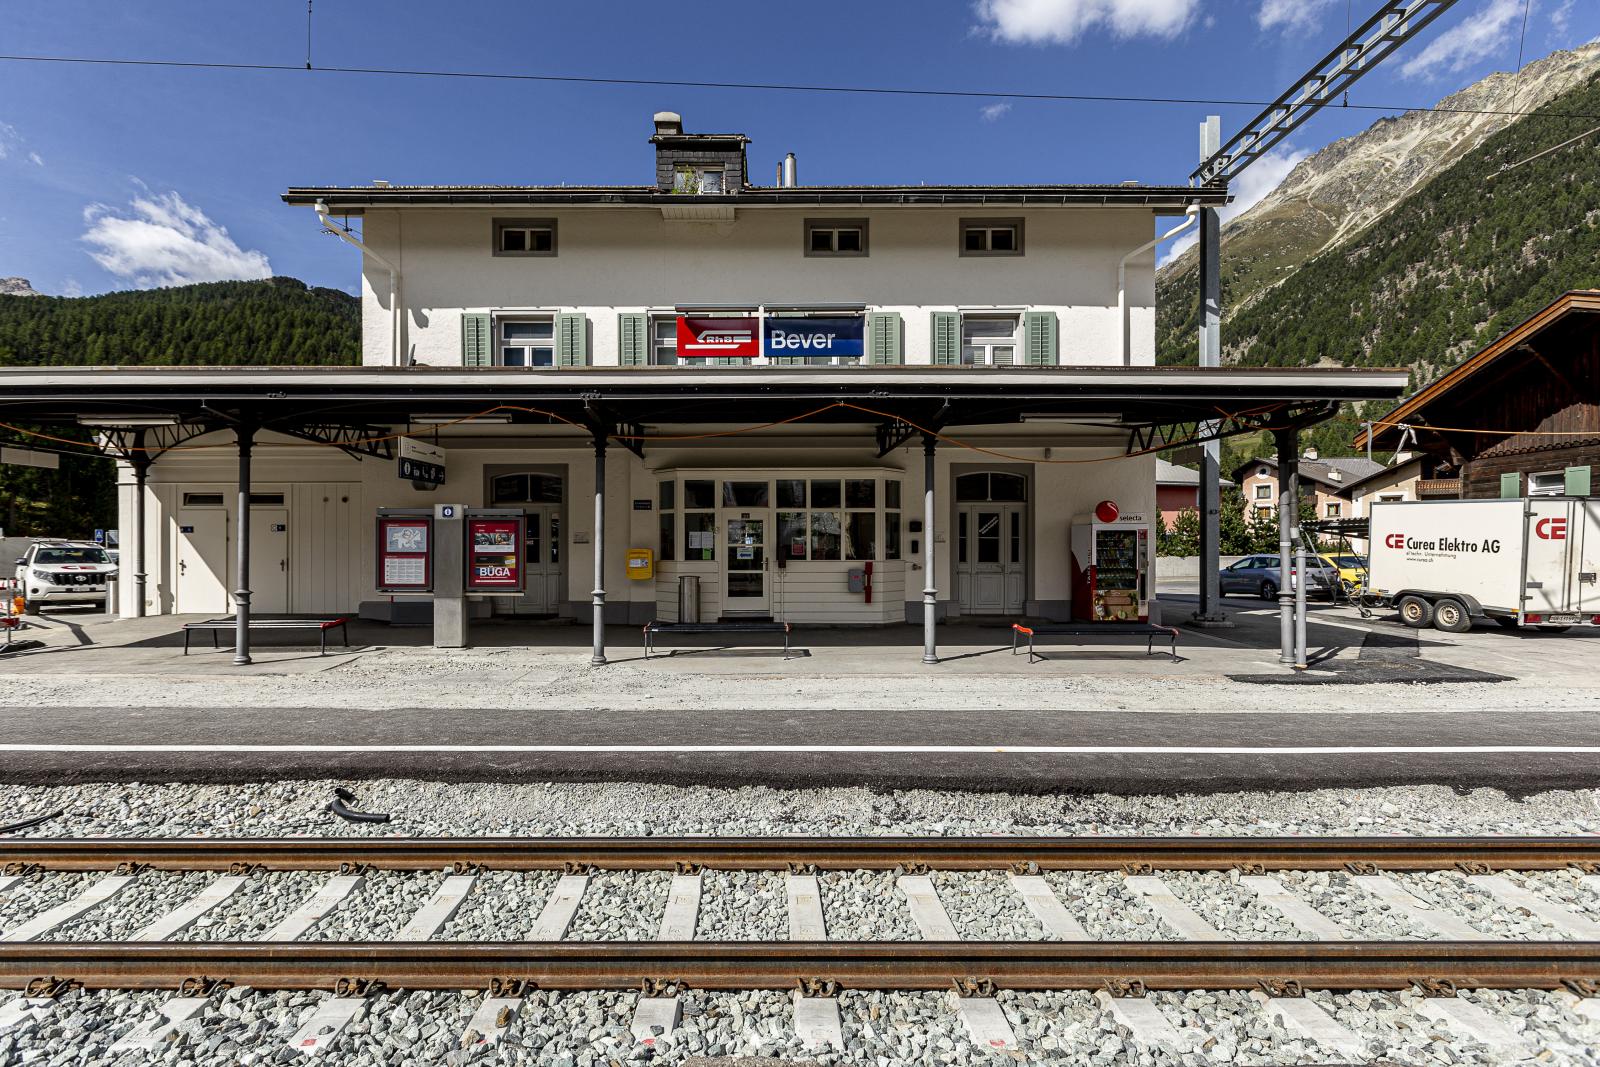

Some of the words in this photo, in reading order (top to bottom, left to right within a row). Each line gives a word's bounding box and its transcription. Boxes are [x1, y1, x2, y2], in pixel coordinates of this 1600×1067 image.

[771, 330, 836, 349] Bever
[1119, 514, 1142, 522] selecta
[1535, 518, 1566, 539] CE
[1385, 534, 1404, 549] CE
[1406, 537, 1435, 551] Curea
[1438, 537, 1478, 553] Elektro
[1481, 539, 1501, 554] AG
[480, 566, 510, 576] BÜGA
